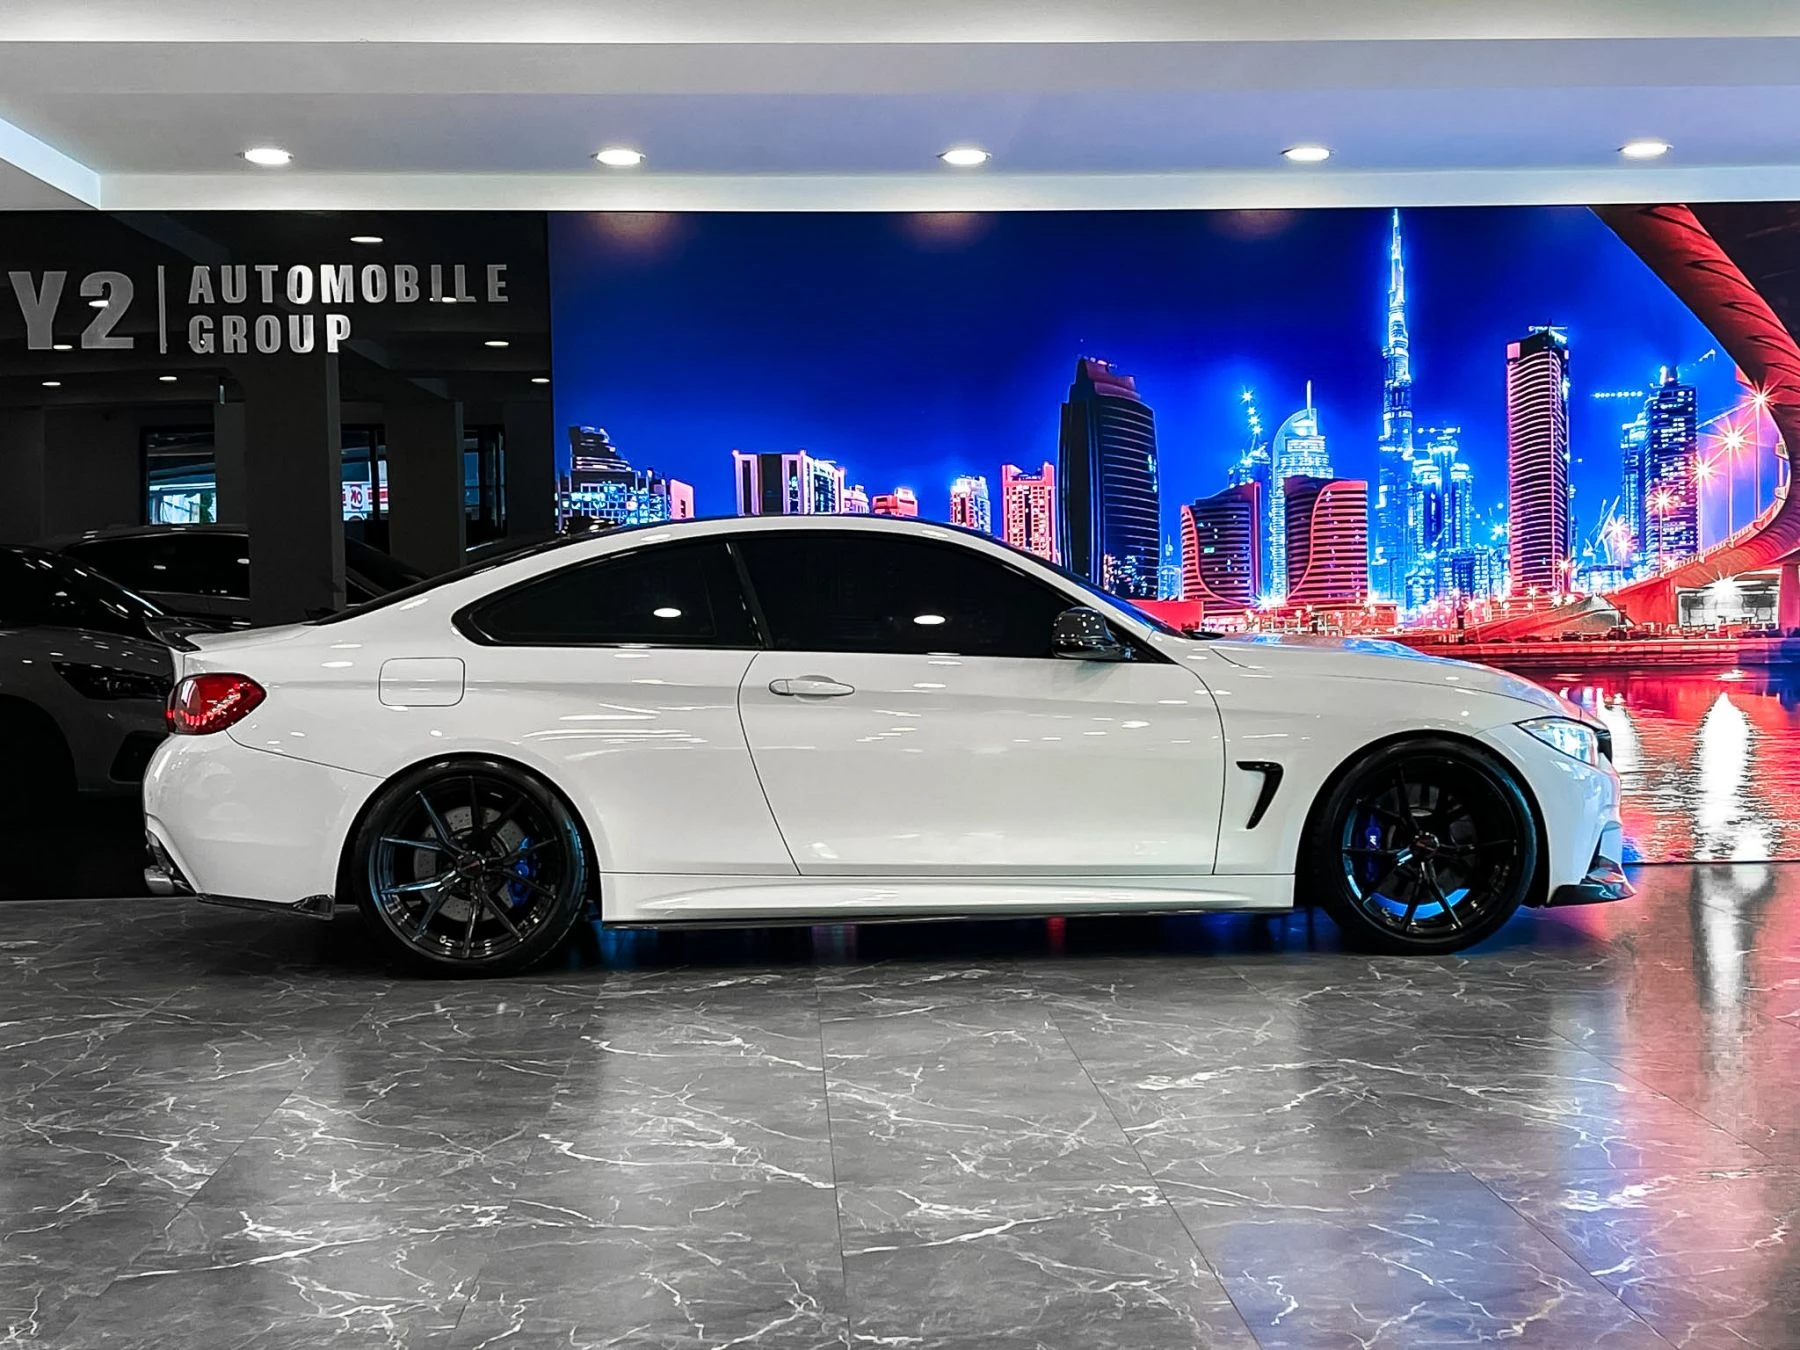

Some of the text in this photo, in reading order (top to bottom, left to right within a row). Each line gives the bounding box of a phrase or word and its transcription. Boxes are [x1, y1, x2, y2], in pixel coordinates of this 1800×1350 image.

[188, 264, 509, 304] AUTOMOBILE
[8, 271, 134, 350] Y2
[188, 314, 351, 354] GROUP
